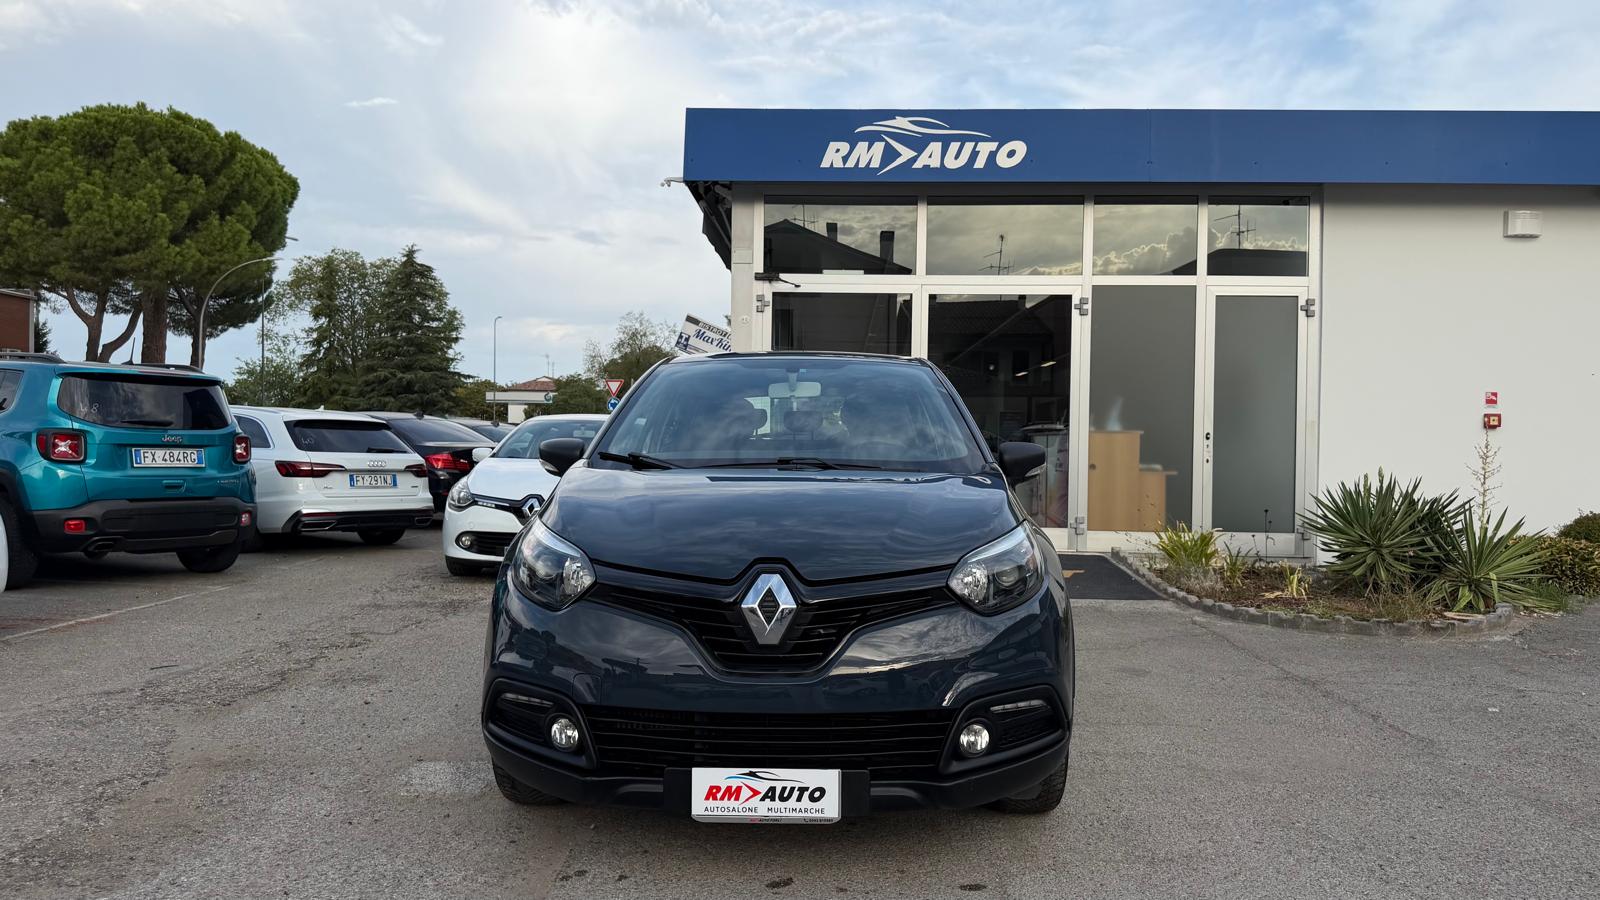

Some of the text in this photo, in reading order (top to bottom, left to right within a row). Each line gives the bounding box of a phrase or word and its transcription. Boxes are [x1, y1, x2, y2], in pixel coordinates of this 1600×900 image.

[819, 140, 1028, 170] RM AUTO
[703, 785, 827, 803] RM AUTO
[703, 806, 825, 815] AUTOSALONE MULTIMARCHE
